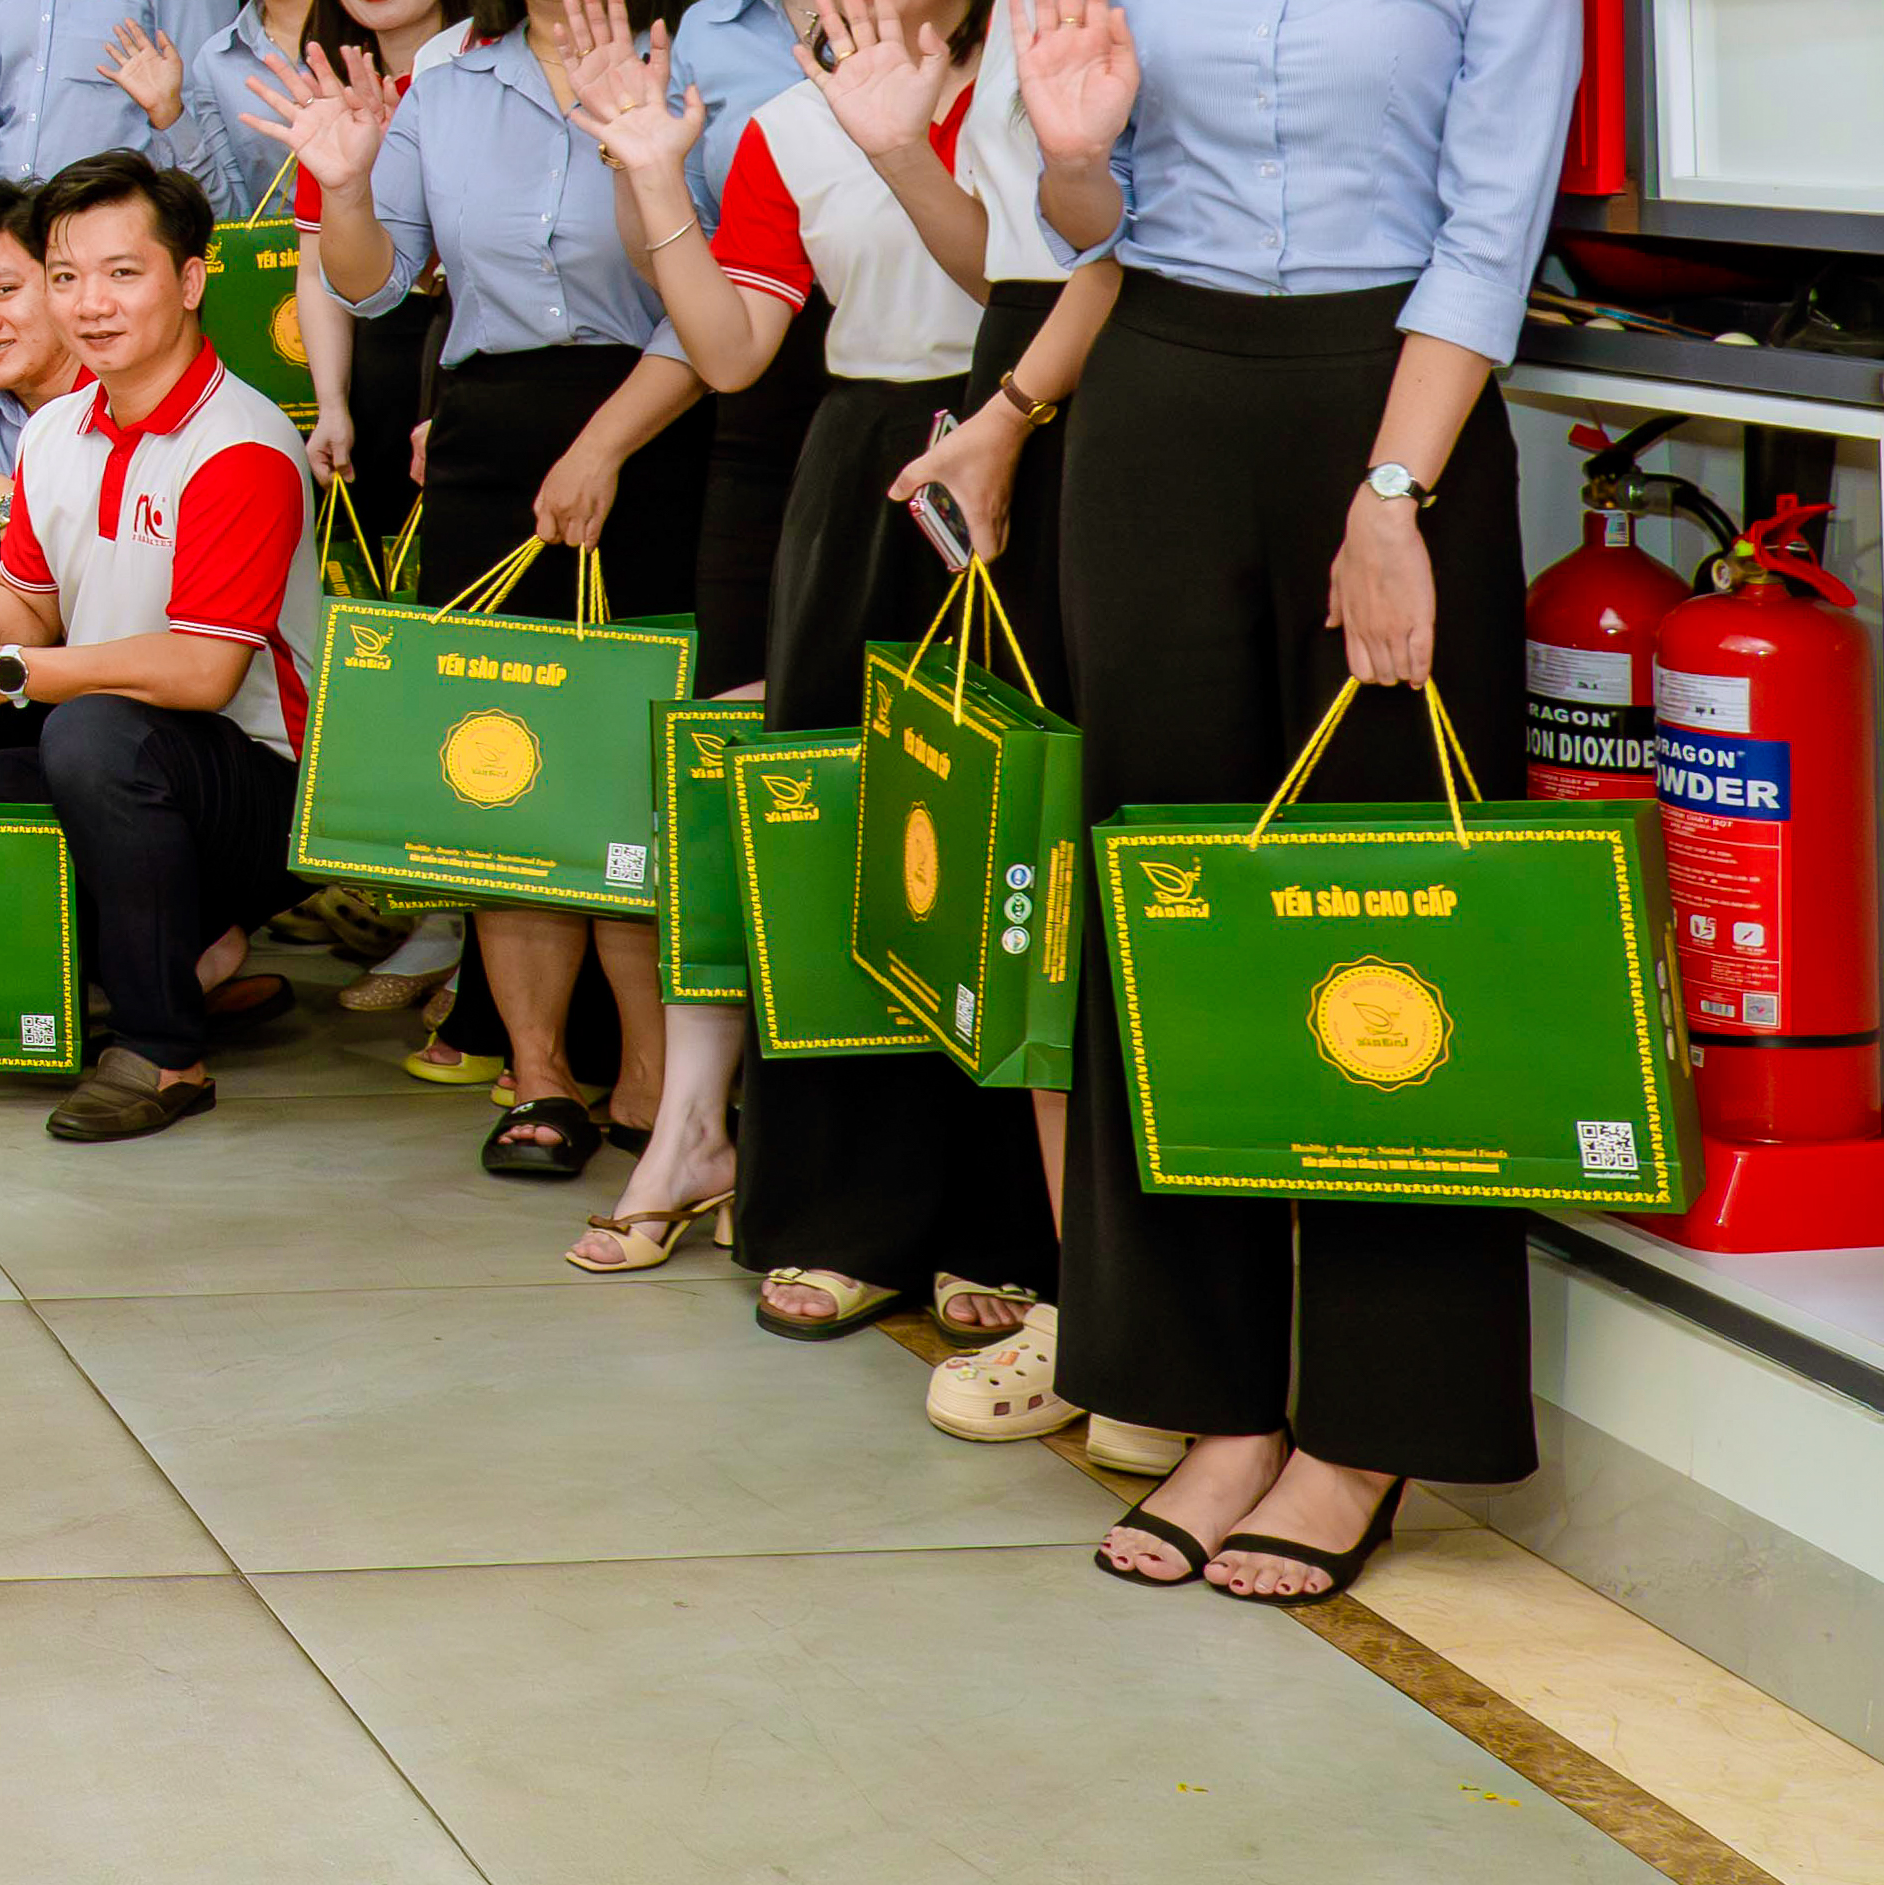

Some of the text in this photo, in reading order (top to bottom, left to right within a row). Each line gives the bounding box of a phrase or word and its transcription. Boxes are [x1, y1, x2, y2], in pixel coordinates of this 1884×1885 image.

[257, 250, 277, 269] YẾN
[437, 652, 567, 688] YẾN SÀO CAO CẤP
[1529, 703, 1610, 728] RAGON
[1559, 733, 1655, 768] DIOXIDE
[1656, 764, 1781, 809] OWDER
[1272, 884, 1458, 918] YẾN SÀO CAO CẤP
